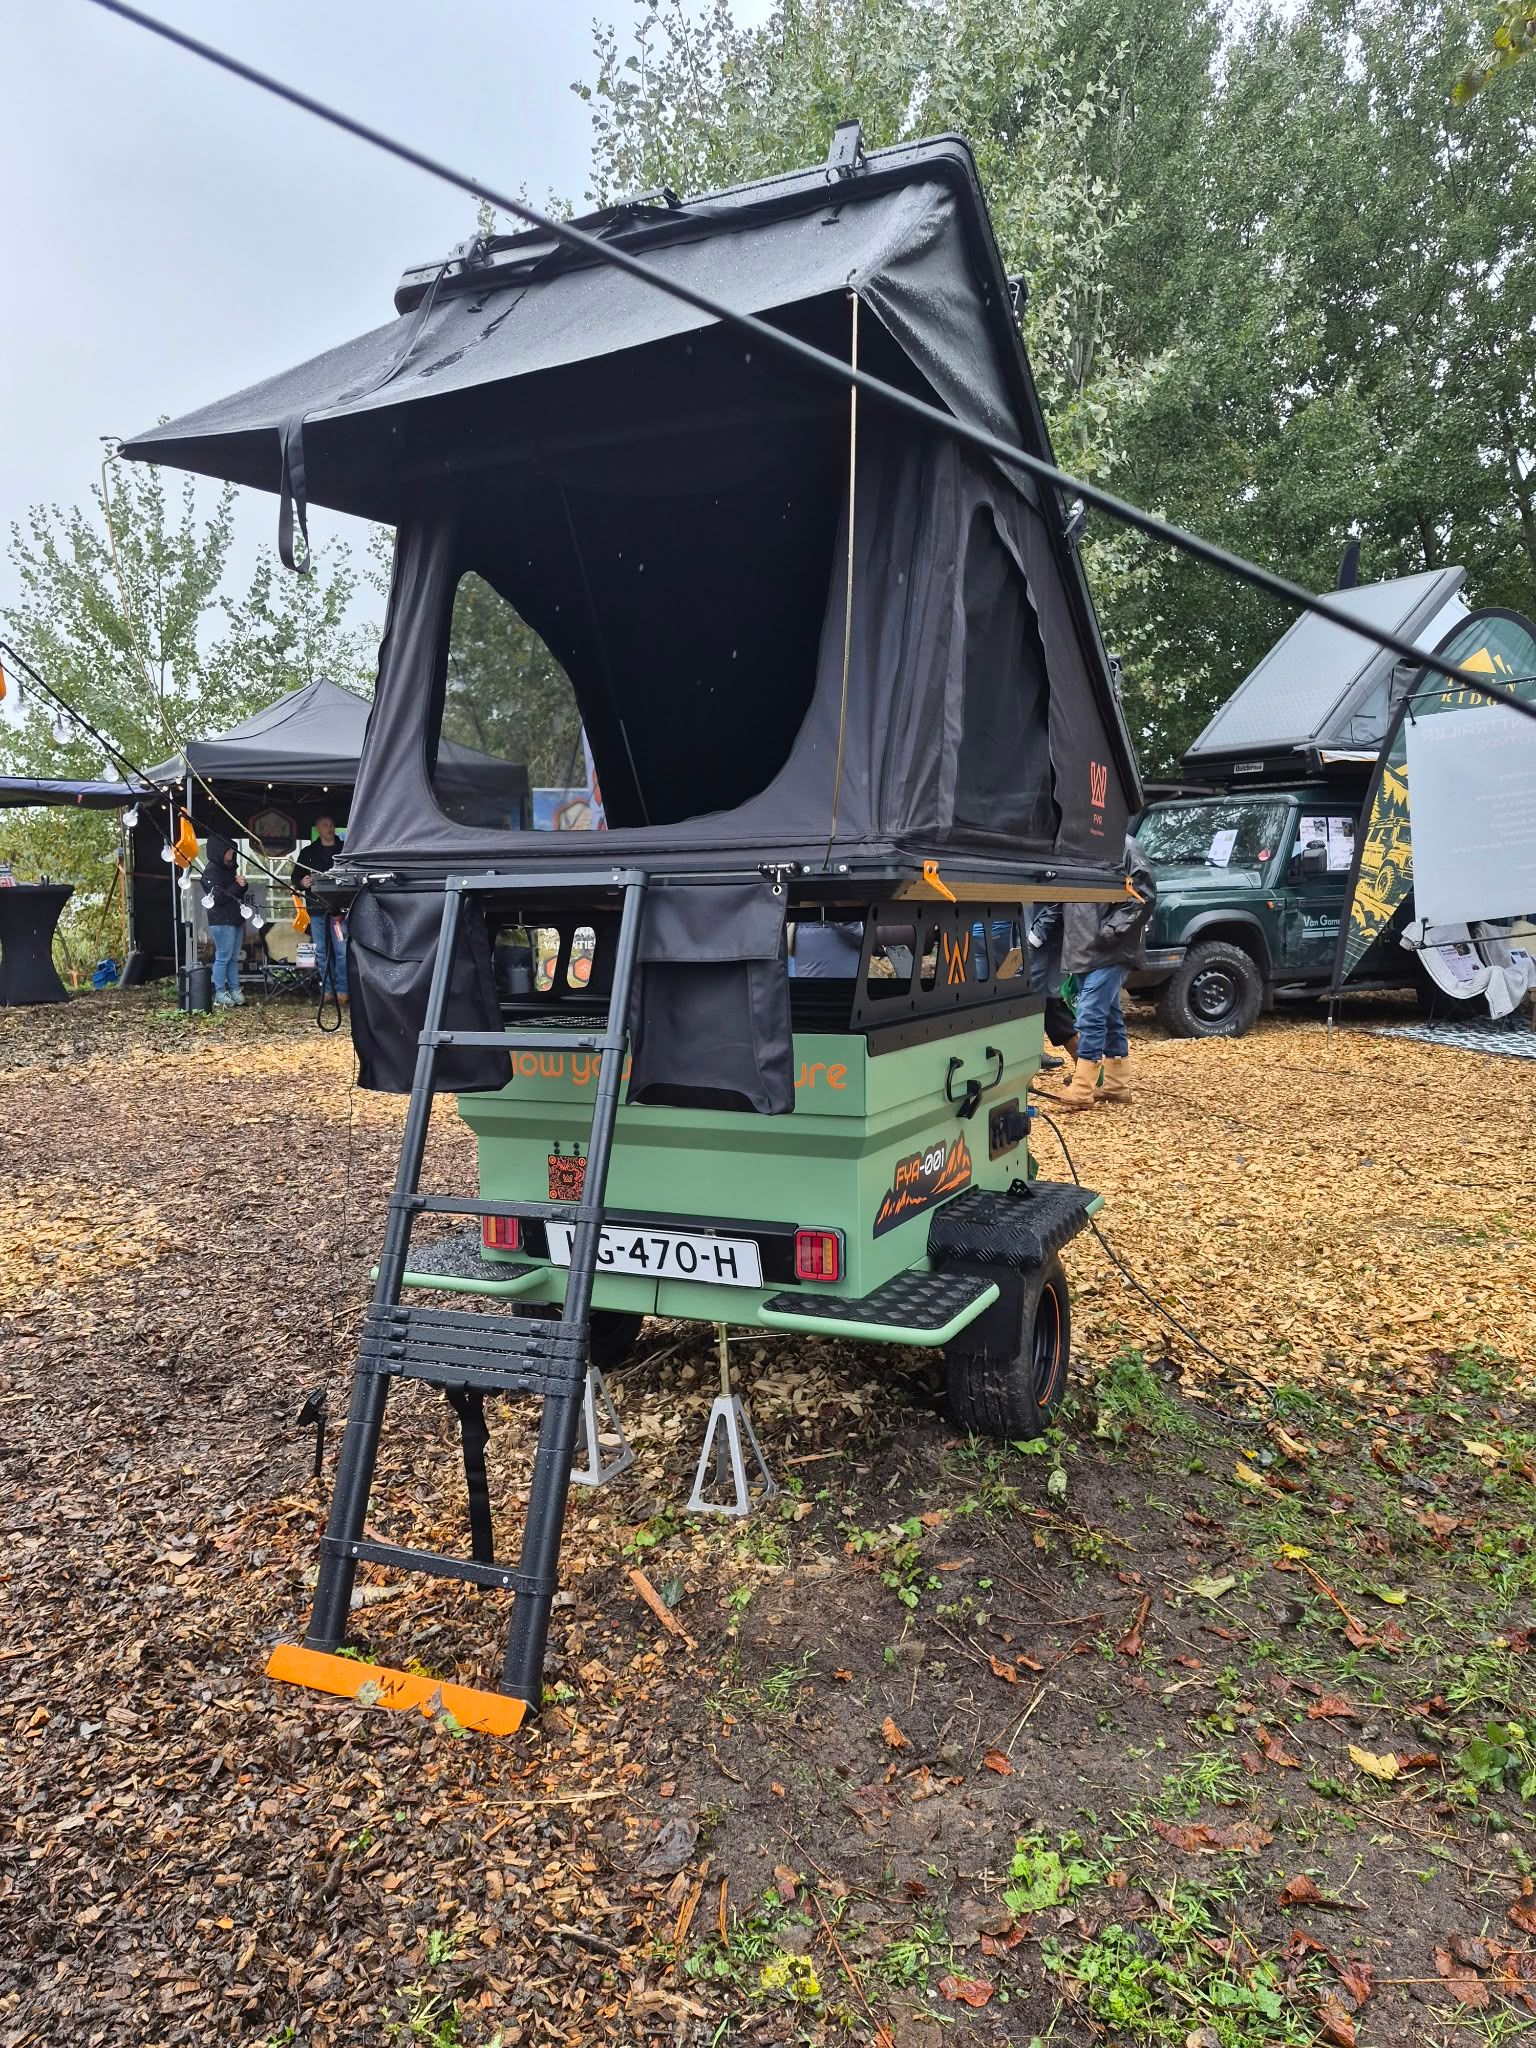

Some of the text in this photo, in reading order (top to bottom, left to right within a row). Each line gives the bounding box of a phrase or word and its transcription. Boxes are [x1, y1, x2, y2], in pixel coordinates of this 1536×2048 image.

[1441, 690, 1499, 707] RIDG
[896, 1147, 945, 1191] FYA-001
[565, 1230, 738, 1279] G-470-H
